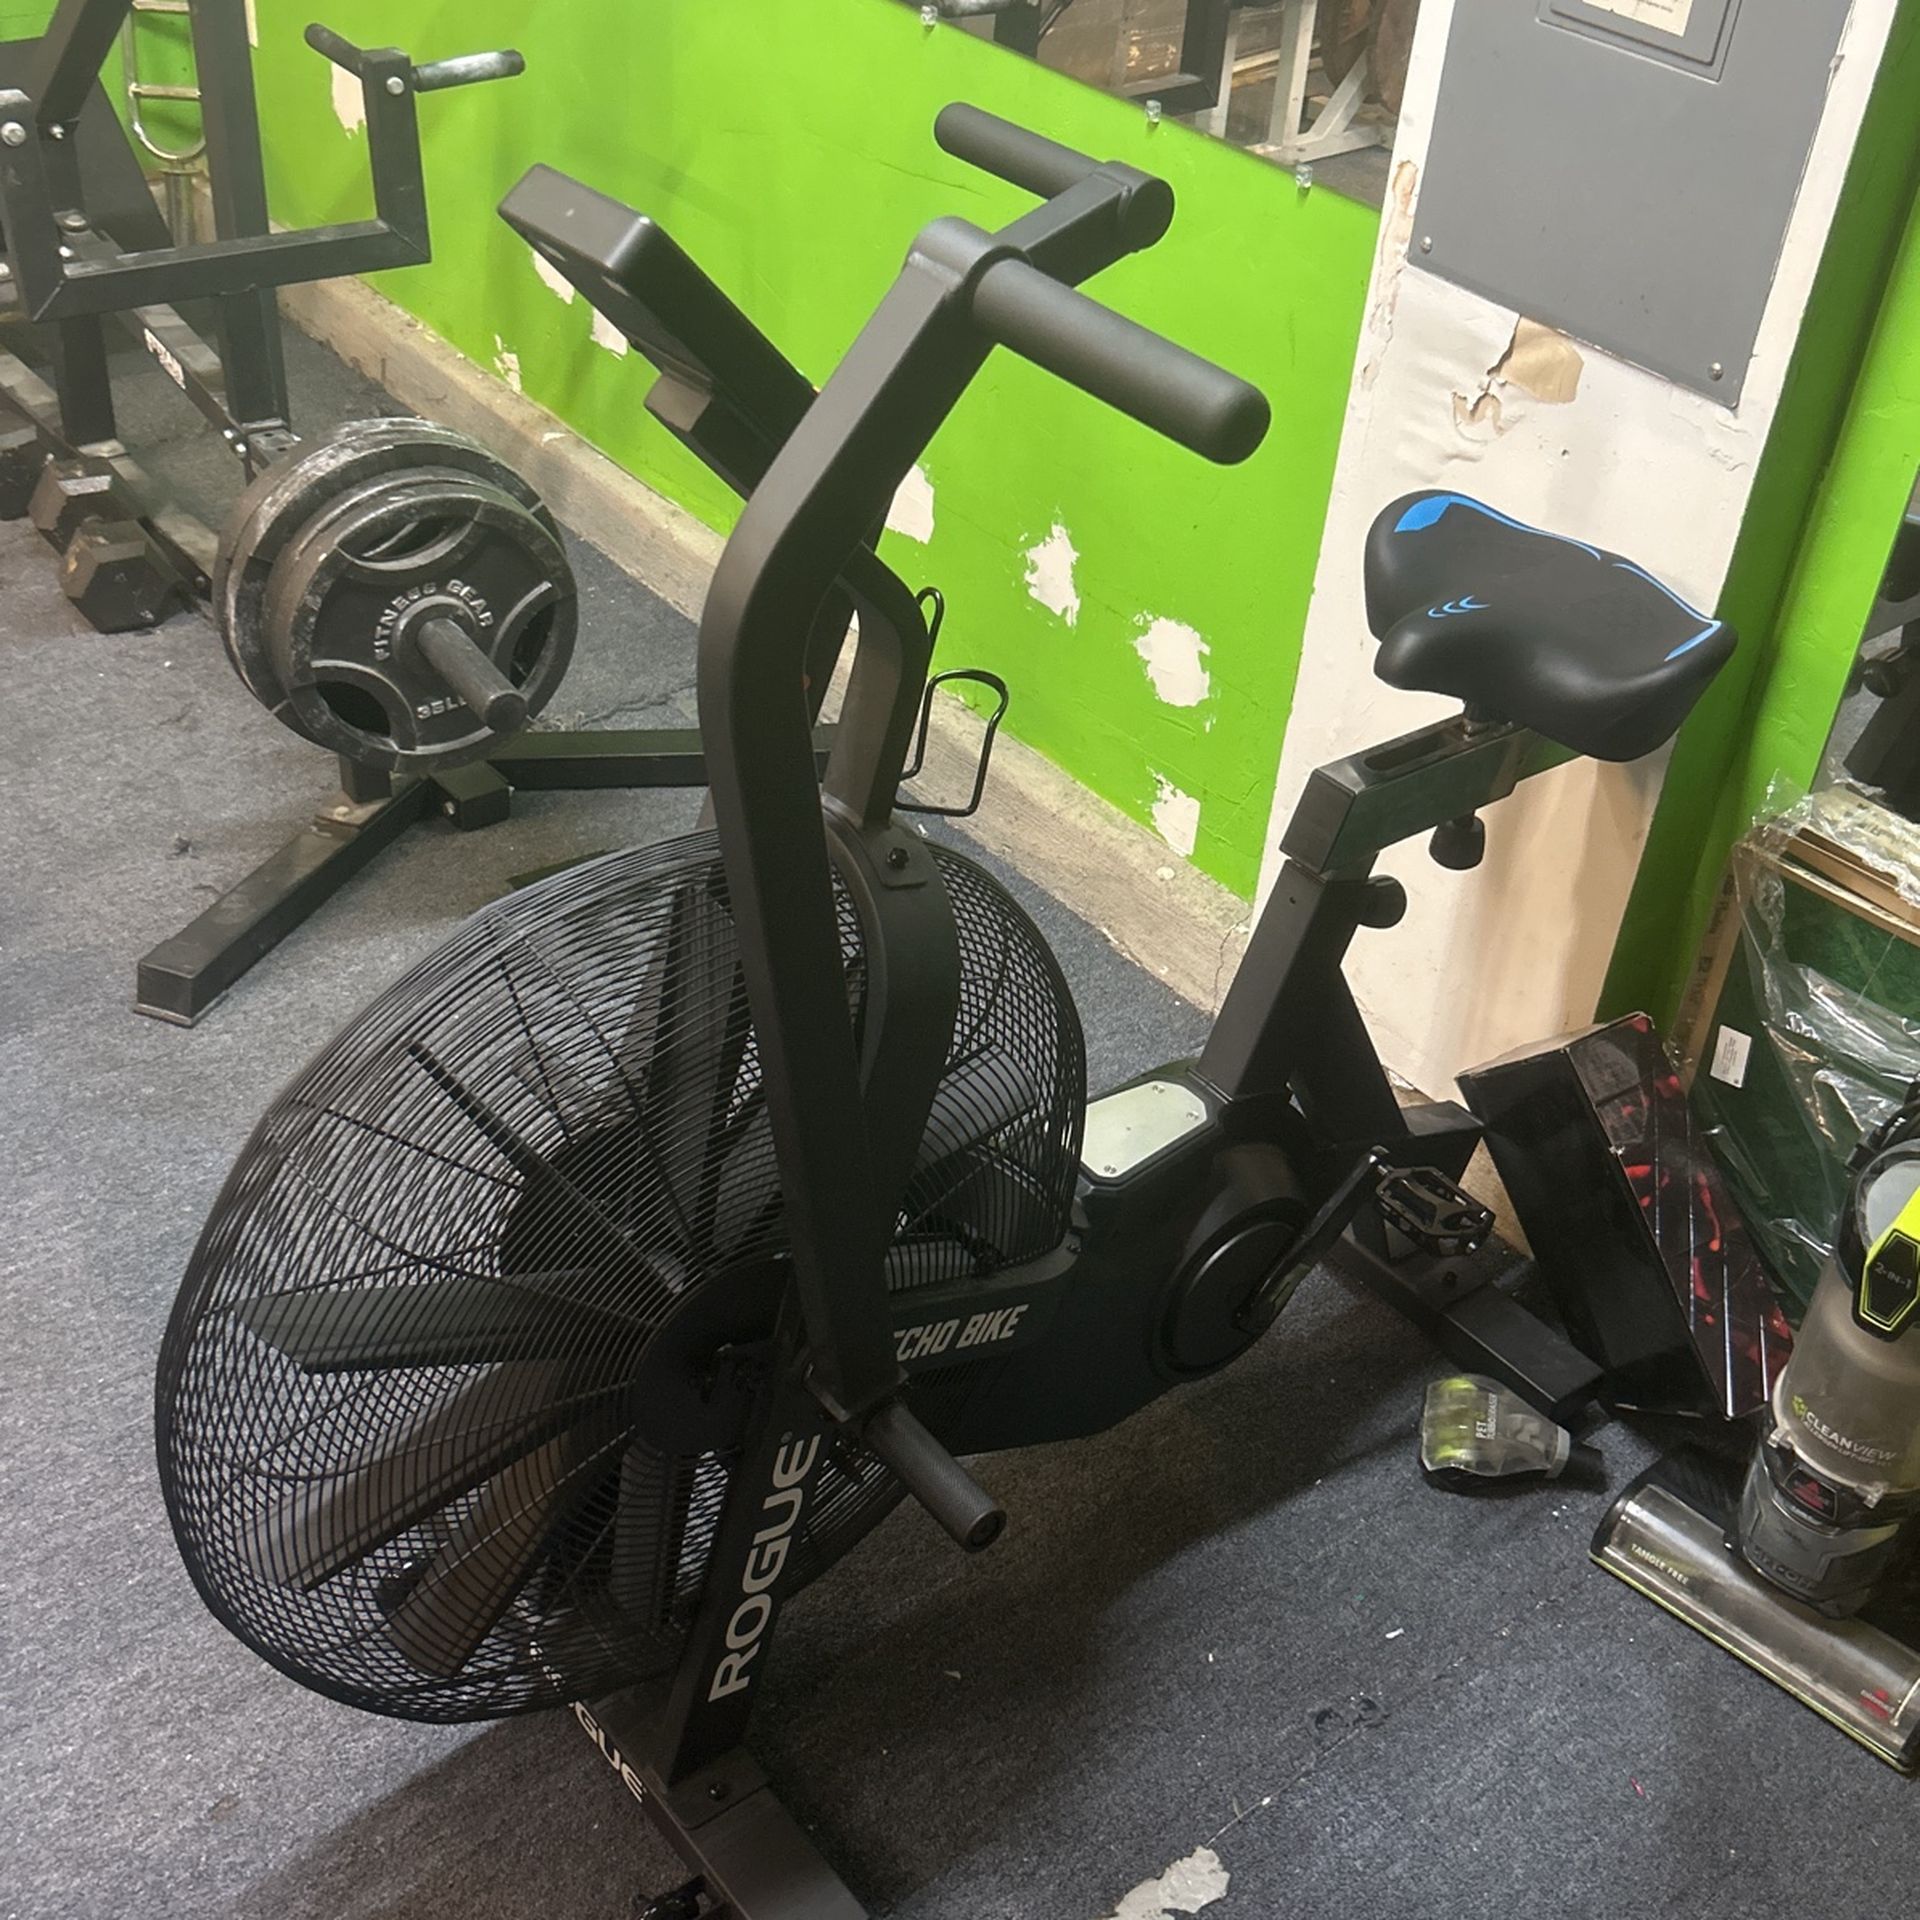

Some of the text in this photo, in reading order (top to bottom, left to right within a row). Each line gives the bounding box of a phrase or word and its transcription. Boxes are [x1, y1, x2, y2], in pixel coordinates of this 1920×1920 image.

[373, 578, 495, 661] FITNESS GEAR
[955, 1304, 1030, 1349] BIKE
[1475, 1420, 1487, 1439] PET
[1806, 1411, 1897, 1461] CLEANVIEW
[708, 1434, 821, 1702] ROGUE
[1666, 1566, 1689, 1585] FREE
